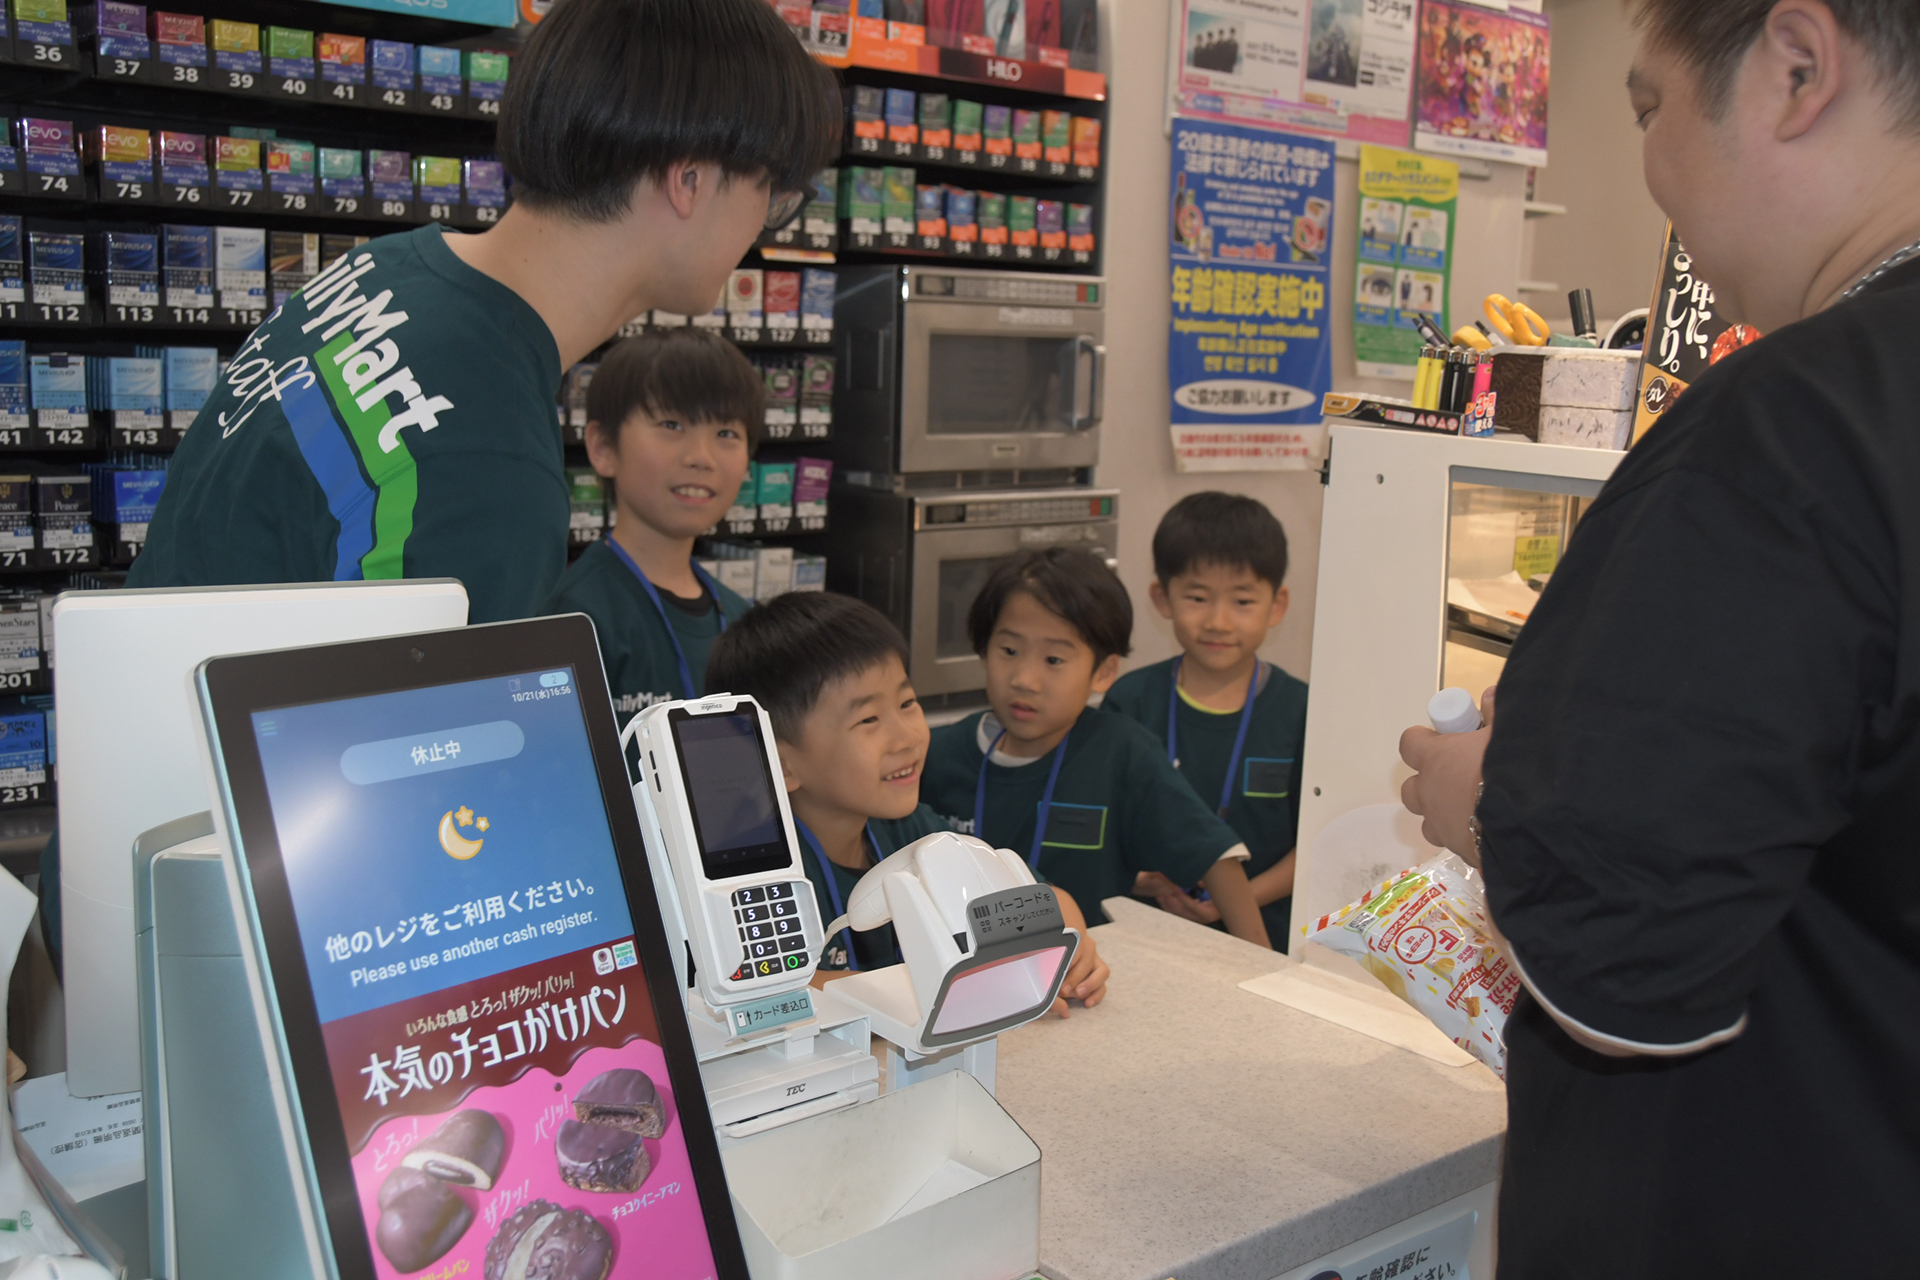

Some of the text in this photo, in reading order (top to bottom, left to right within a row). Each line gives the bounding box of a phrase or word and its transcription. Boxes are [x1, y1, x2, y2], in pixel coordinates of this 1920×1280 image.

[823, 31, 842, 46] 22
[34, 45, 62, 61] 36
[115, 60, 140, 76] 37
[173, 65, 198, 83] 38
[987, 59, 1022, 82] HILO
[229, 72, 254, 88] 39
[282, 79, 306, 95] 40
[333, 85, 354, 100] 41
[383, 91, 405, 105] 42
[431, 96, 453, 110] 43
[478, 101, 500, 115] 44
[29, 126, 62, 140] evo
[107, 133, 138, 148] evo
[166, 138, 195, 153] evo
[861, 138, 878, 152] 53
[221, 143, 249, 156] evo
[895, 143, 911, 155] 54
[927, 146, 944, 160] 55
[960, 151, 976, 164] 56
[991, 154, 1006, 167] 57
[1021, 157, 1036, 171] 58
[1050, 163, 1066, 175] 59
[41, 176, 69, 191] 74
[117, 183, 142, 198] 75
[175, 187, 200, 202] 76
[229, 191, 253, 206] 77
[283, 195, 306, 210] 78
[334, 198, 357, 212] 79
[382, 201, 405, 216] 80
[430, 205, 450, 219] 81
[477, 208, 498, 222] 82
[111, 241, 142, 251] MEVIUS
[858, 234, 874, 247] 91
[892, 233, 908, 247] 92
[924, 235, 940, 249] 93
[955, 240, 971, 253] 94
[36, 246, 66, 255] MEVIUS
[986, 243, 1002, 256] 95
[1017, 245, 1032, 259] 96
[1046, 247, 1060, 260] 97
[1172, 264, 1324, 320] 年齢確認実施中
[40, 306, 80, 321] 112
[117, 307, 154, 321] 113
[173, 308, 210, 324] 114
[227, 310, 262, 325] 115
[734, 329, 760, 342] 126
[771, 330, 796, 343] 127
[1188, 388, 1291, 407] ご協力お願いします
[45, 430, 84, 444] 142
[122, 431, 159, 445] 143
[768, 426, 793, 438] 157
[54, 501, 79, 511] Peace
[51, 549, 90, 564] 172
[0, 674, 32, 688] 201
[512, 685, 573, 703] 10/21(水)16:56
[411, 740, 462, 766] 休止中
[2, 787, 40, 803] 231
[743, 891, 752, 902] 2
[771, 887, 780, 897] 3
[776, 904, 784, 914] 6
[994, 892, 1051, 914] バーコードを
[324, 878, 595, 962] 他のレジをご利用ください。
[748, 909, 756, 920] 5
[998, 907, 1056, 927] スキャンしてください
[752, 926, 760, 938] 8
[780, 921, 788, 932] 9
[350, 910, 598, 988] Please use another cash register.
[756, 944, 764, 955] 0
[406, 1006, 470, 1038] いろんな食感
[508, 981, 543, 1008] ザクッ!
[544, 971, 576, 996] パリッ!
[754, 997, 809, 1021] カード差込口
[363, 985, 627, 1107] 本気のチョコがけパン
[786, 1083, 806, 1096] TEC
[533, 1093, 570, 1146] パリッ!
[481, 1179, 531, 1229] ザクッ!
[611, 1181, 682, 1220] チョコクイニーアマン
